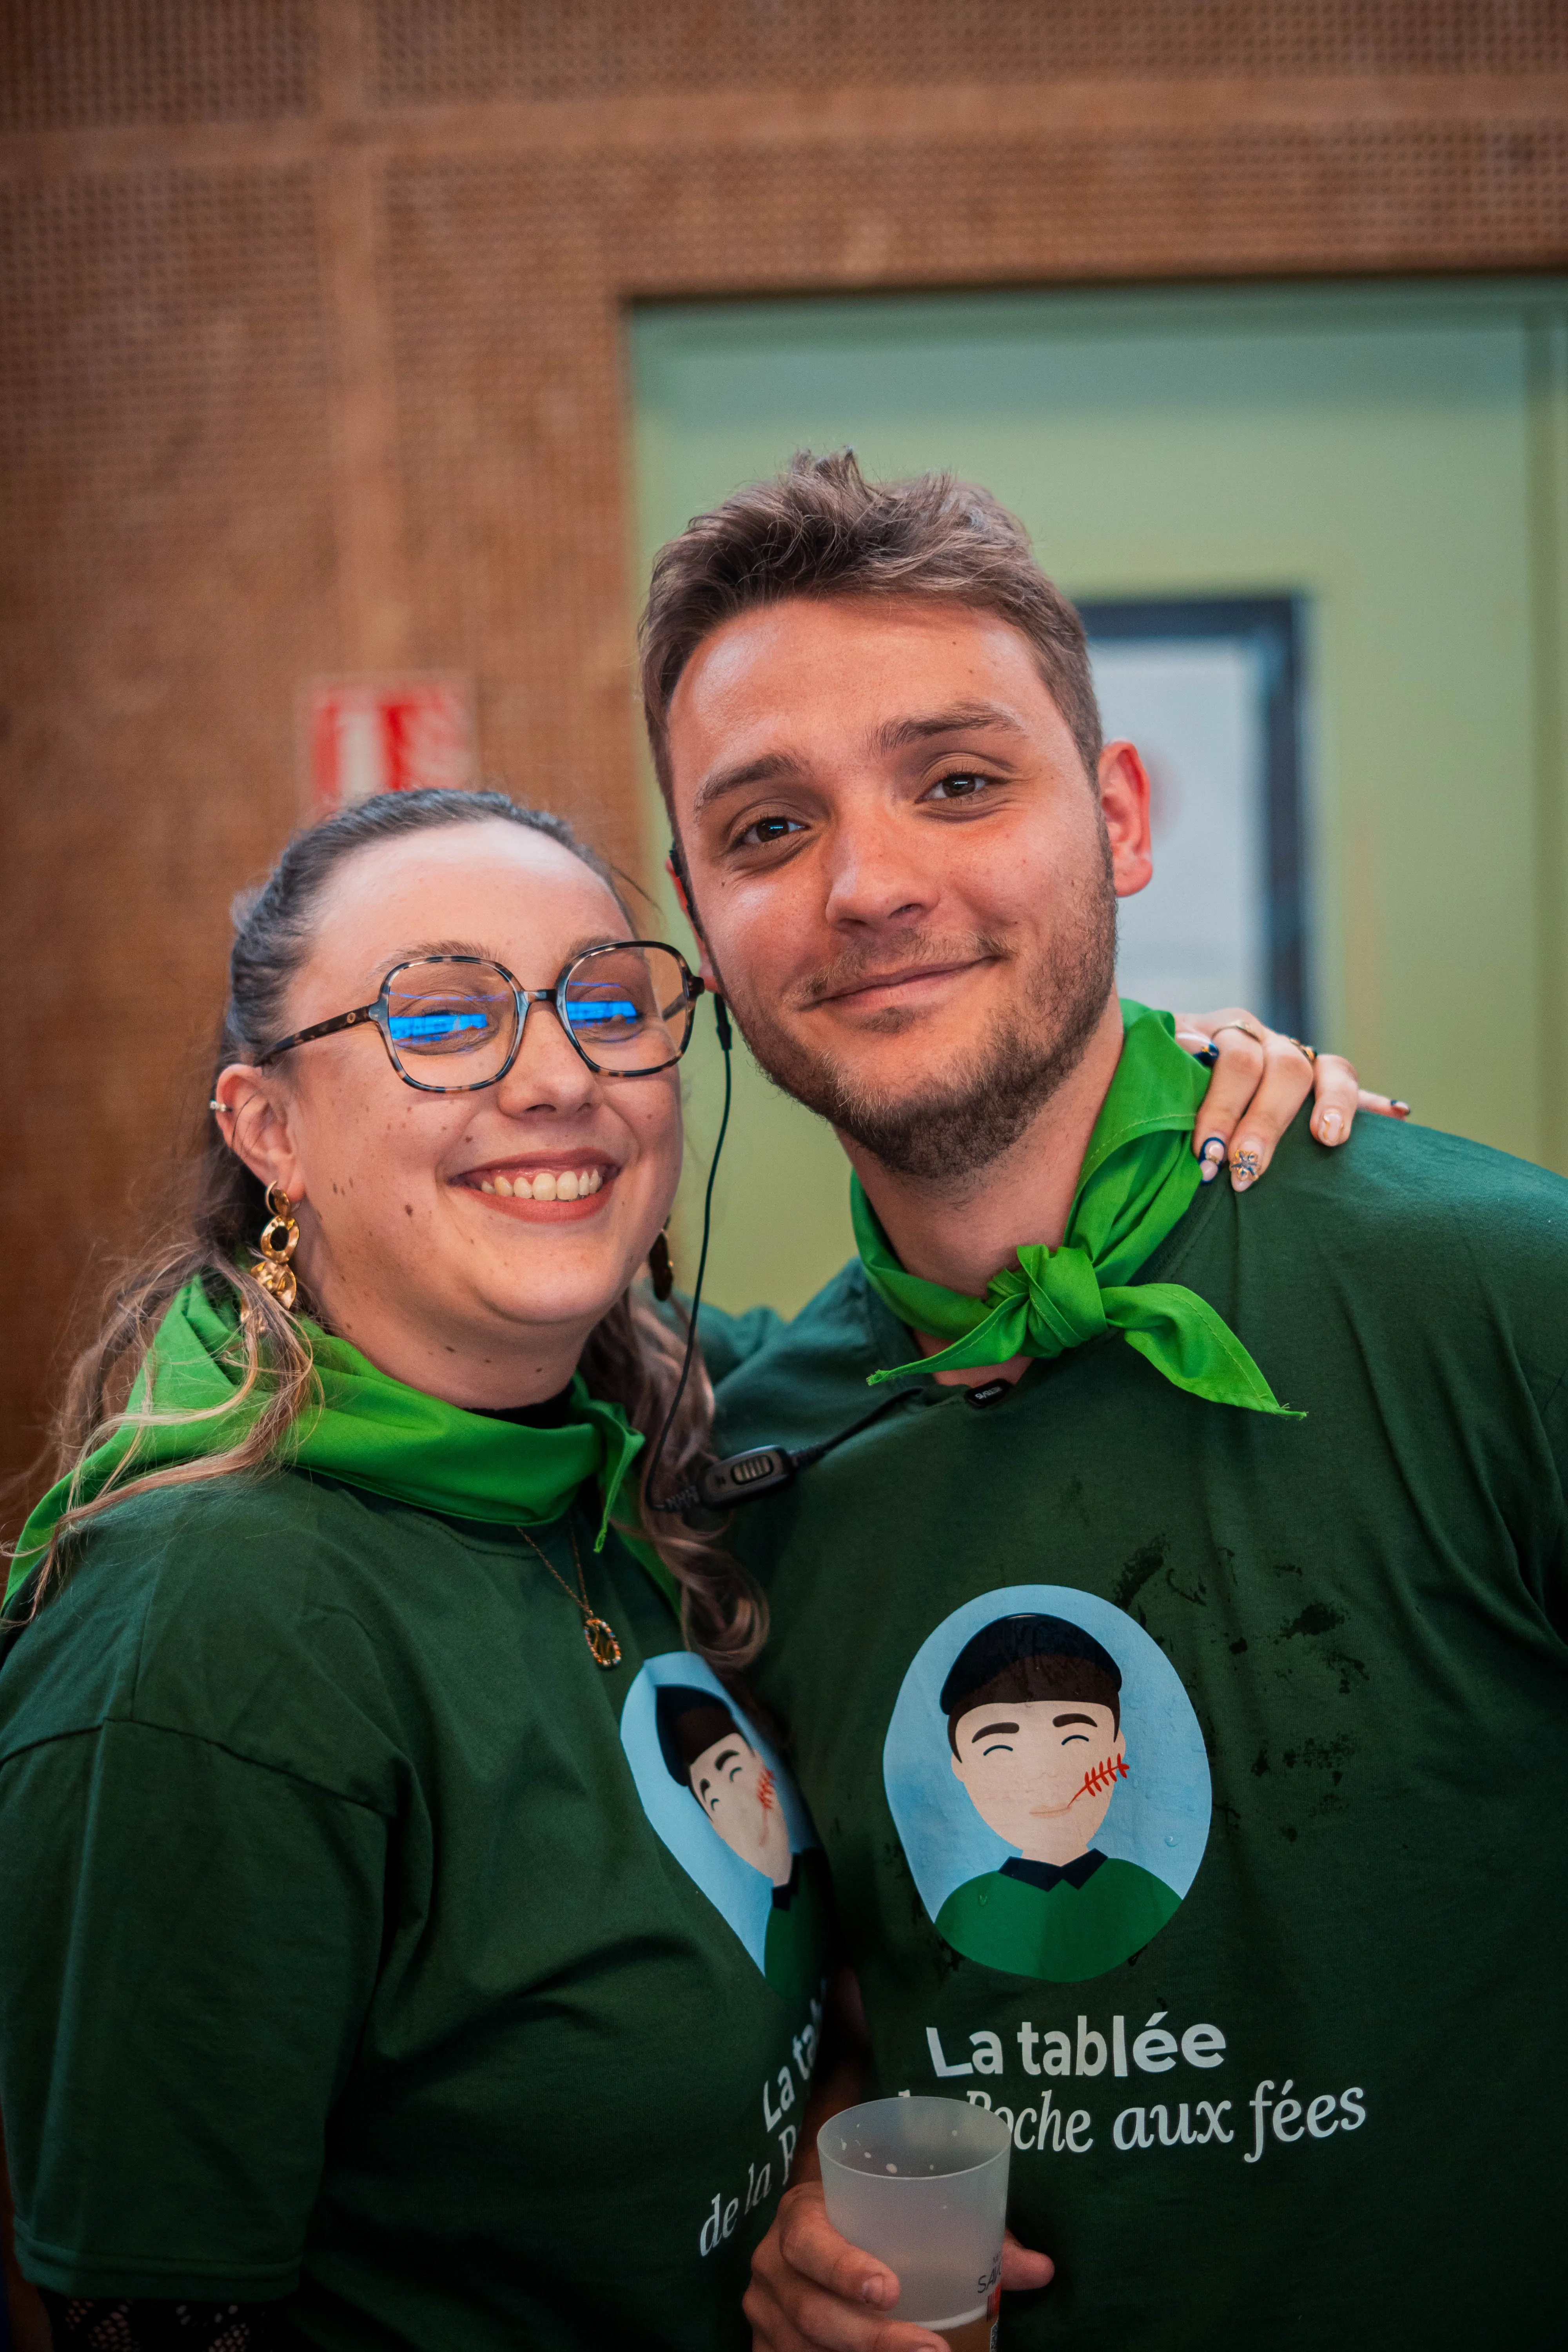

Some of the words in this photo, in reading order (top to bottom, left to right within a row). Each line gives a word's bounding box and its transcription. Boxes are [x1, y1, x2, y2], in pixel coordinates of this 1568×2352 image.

[926, 2027, 1003, 2077] La
[1017, 2011, 1226, 2077] tablée
[762, 2065, 795, 2133] La
[1113, 2100, 1234, 2150] aux
[1244, 2079, 1366, 2163] fées
[700, 2193, 739, 2257] de
[744, 2162, 772, 2215] la
